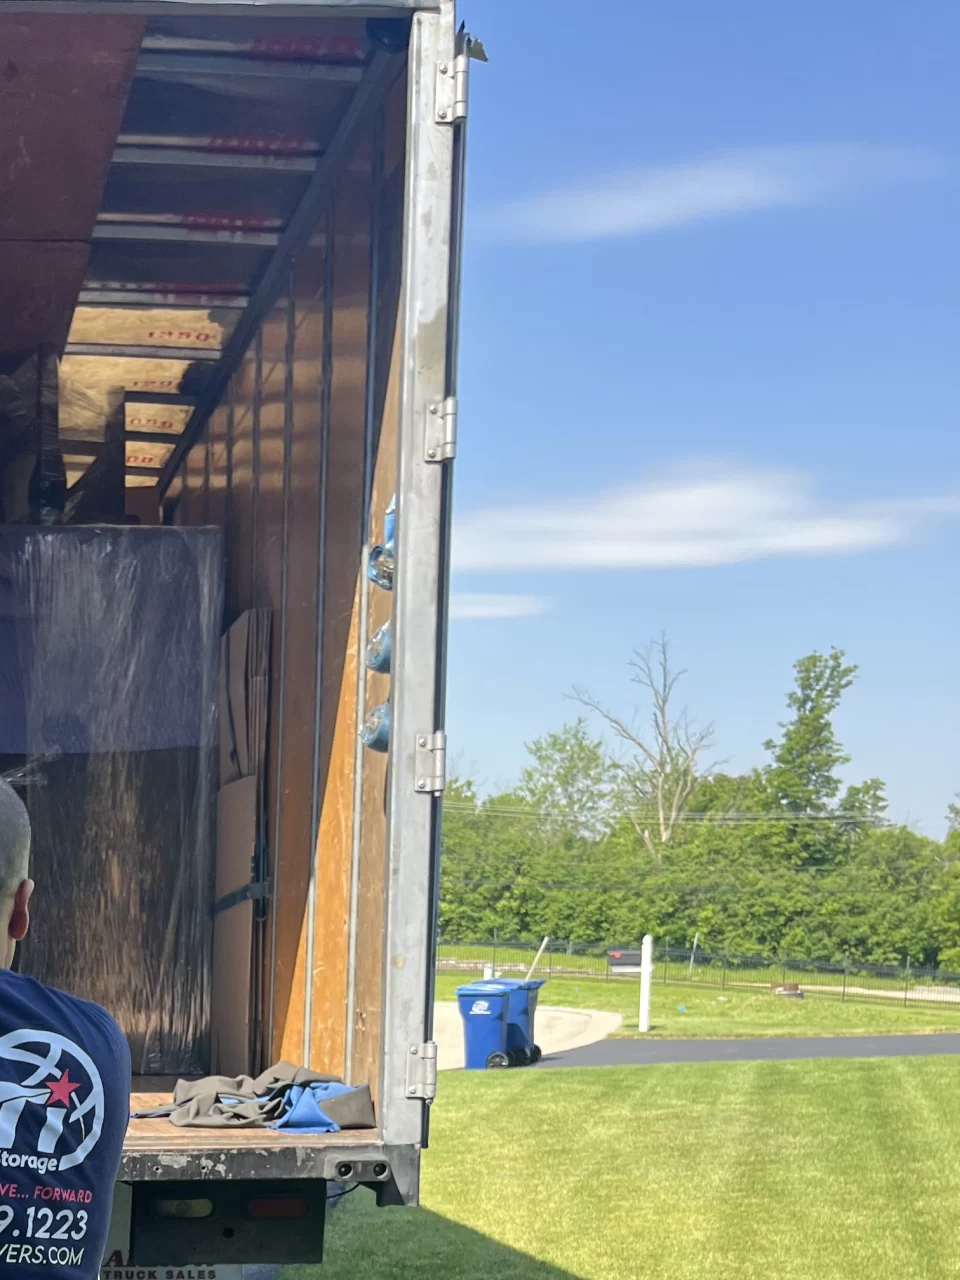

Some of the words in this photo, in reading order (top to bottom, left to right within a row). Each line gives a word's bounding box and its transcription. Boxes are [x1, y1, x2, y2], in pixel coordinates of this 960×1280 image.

[34, 1186, 92, 1203] FORWARD
[103, 1270, 157, 1280] TRUCK
[165, 1270, 217, 1280] SALES
